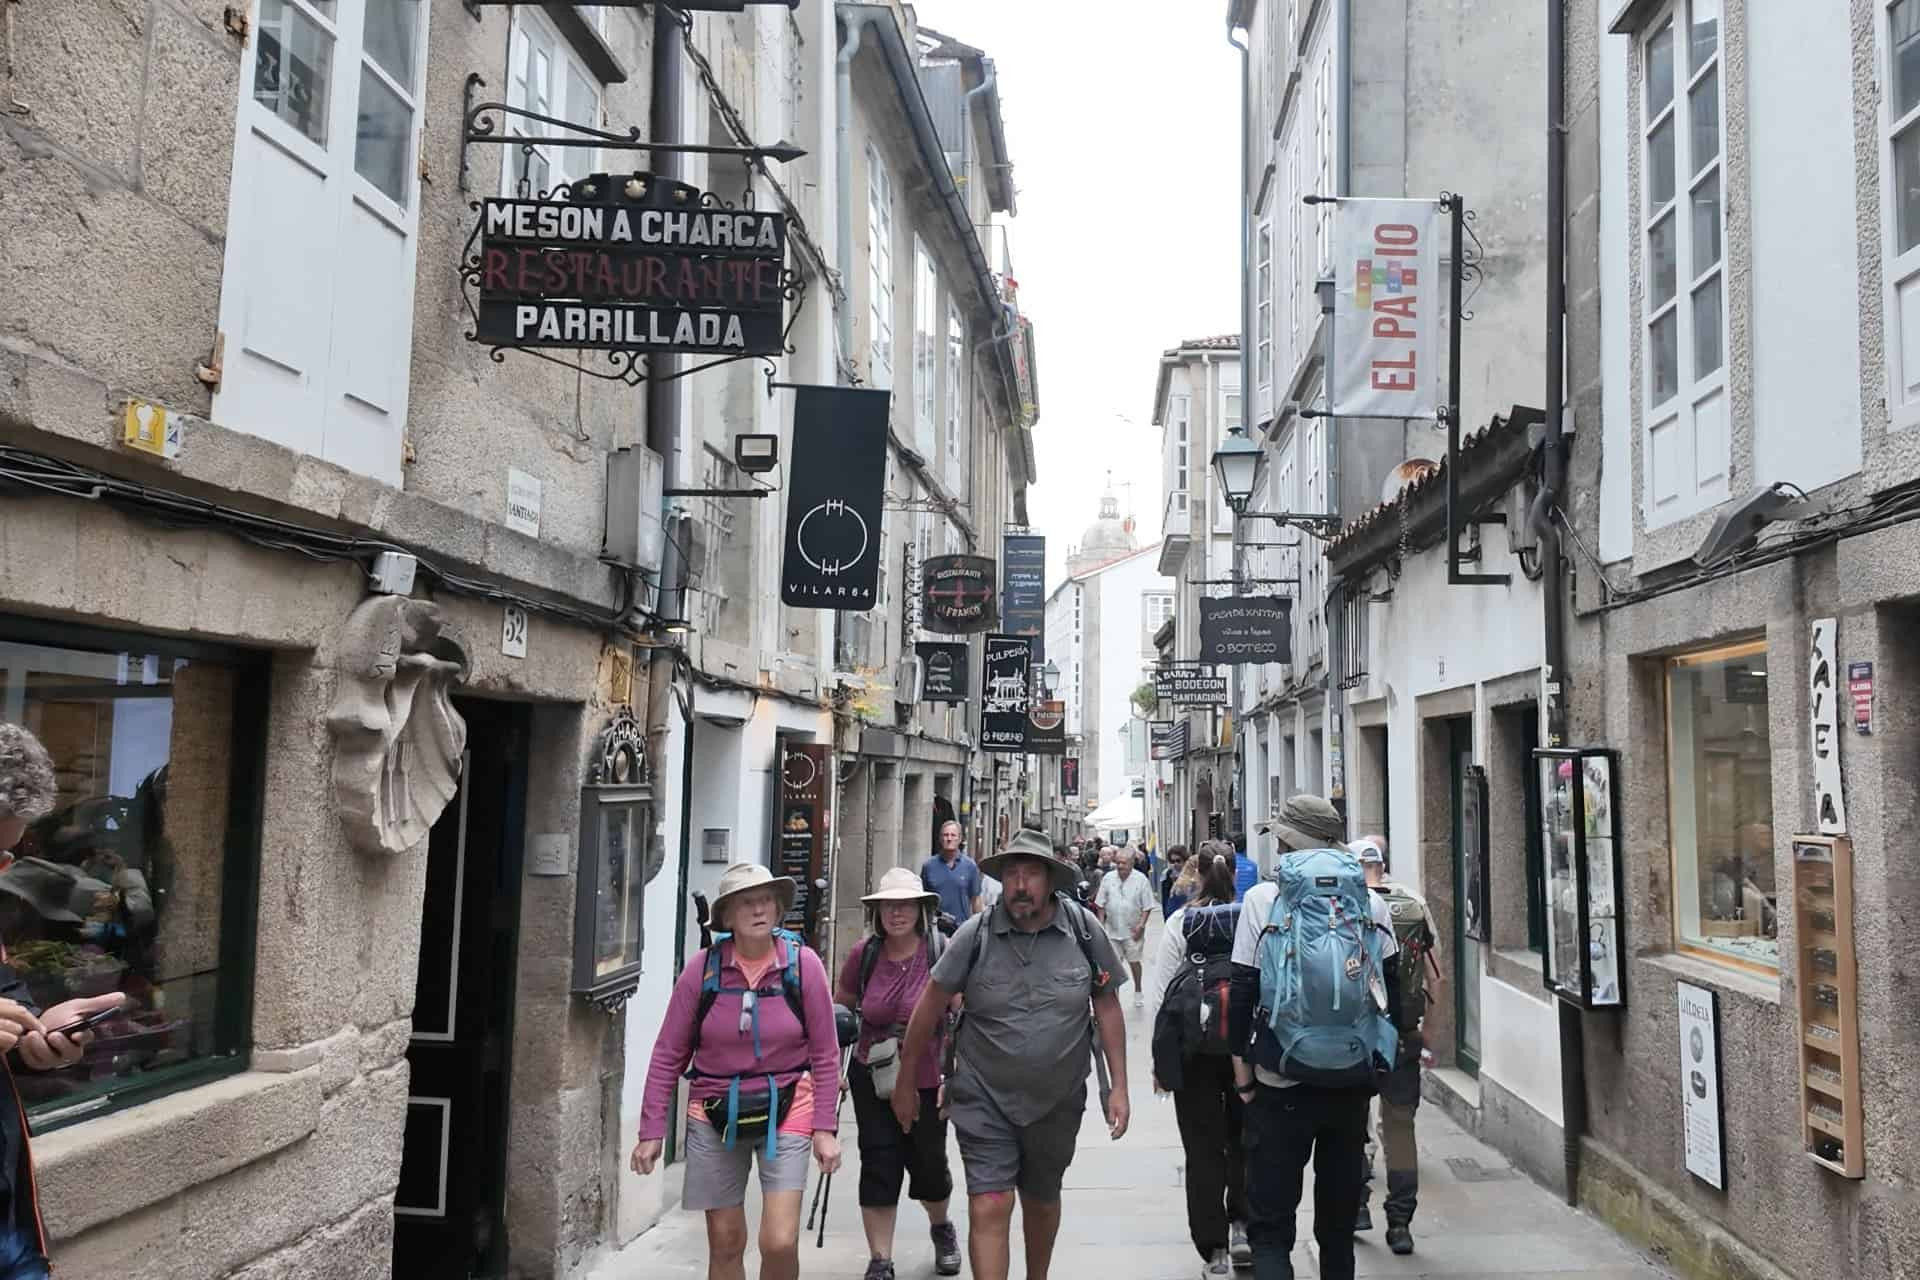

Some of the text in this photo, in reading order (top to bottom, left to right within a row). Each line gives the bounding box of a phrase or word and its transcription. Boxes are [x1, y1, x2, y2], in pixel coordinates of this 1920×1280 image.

[487, 202, 778, 248] MESON A CHARCA
[484, 248, 773, 302] RESTAURANTE
[515, 305, 745, 347] PARRILLADA
[1371, 350, 1416, 391] EL
[1216, 642, 1277, 654] O BOTECO
